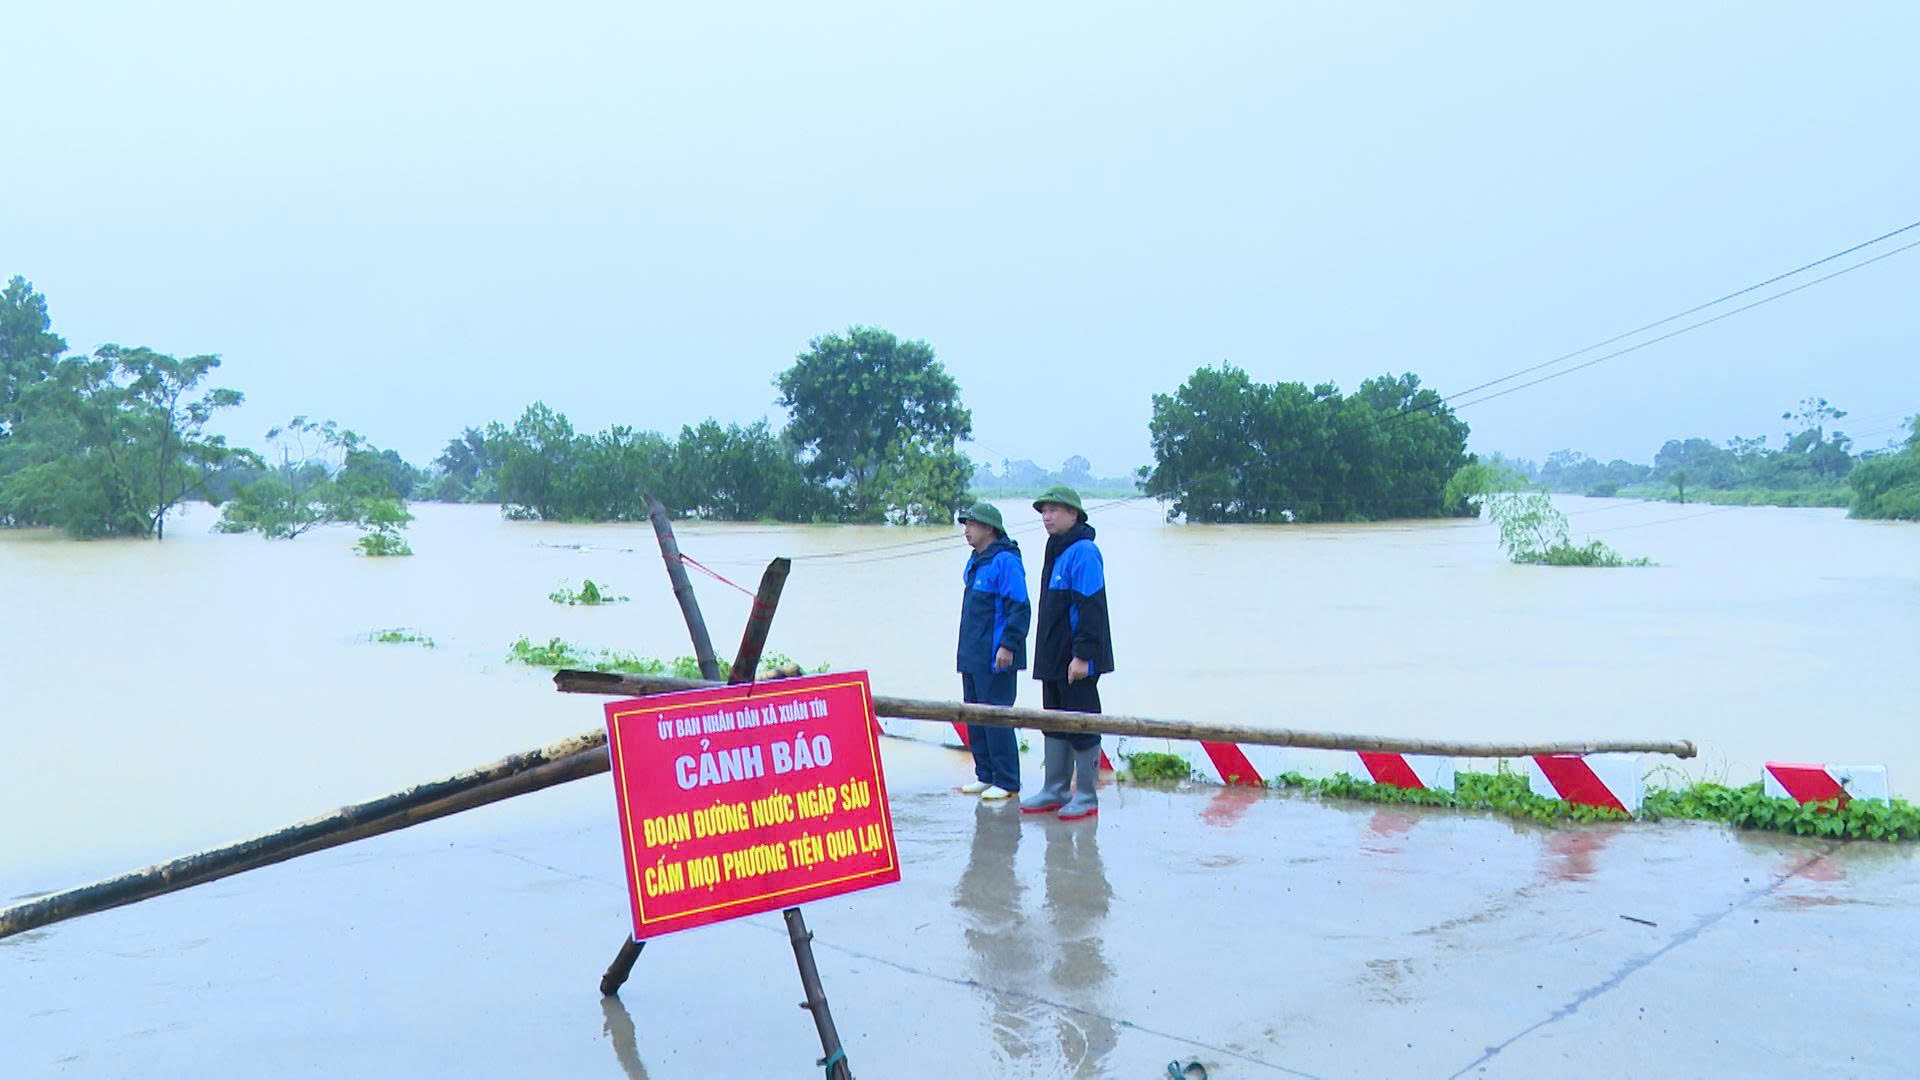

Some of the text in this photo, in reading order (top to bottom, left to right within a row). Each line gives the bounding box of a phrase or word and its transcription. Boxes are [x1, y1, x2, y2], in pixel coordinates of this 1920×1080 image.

[657, 697, 828, 740] ỦY BAN NHÂN DÂN XÃ XUÂN TÍN
[675, 731, 833, 790] CẢNH BÁO
[643, 777, 871, 850] ĐOẠN ĐƯỜNG NƯỚC NGẬP SÂU
[645, 823, 883, 897] CẤM MỌI PHƯƠNG TIỆN QUA LẠI
